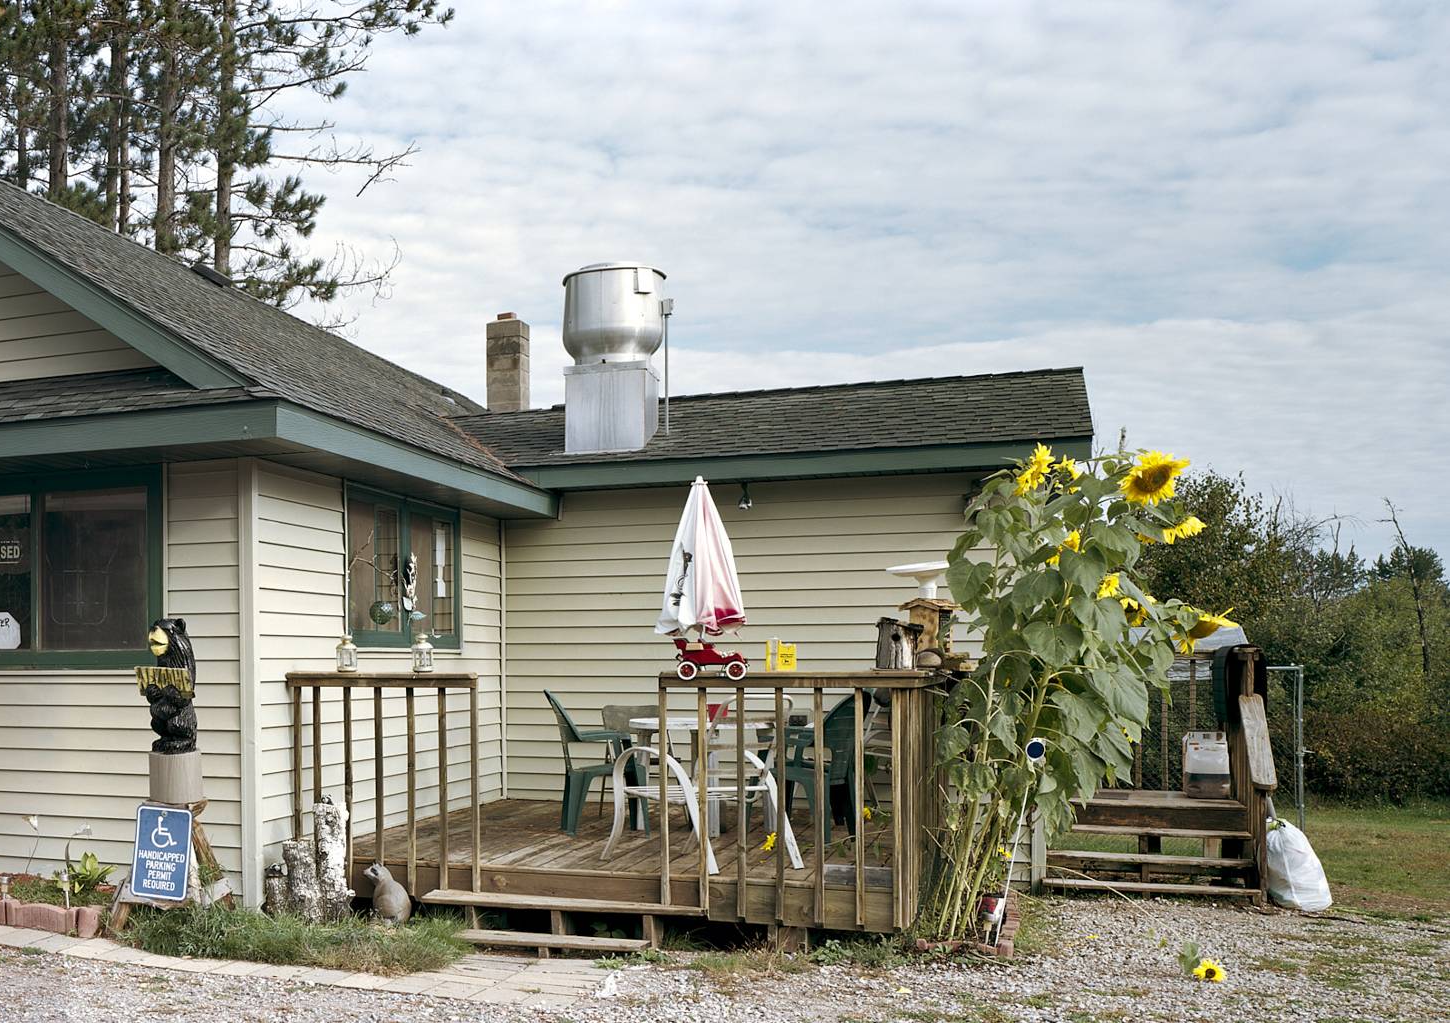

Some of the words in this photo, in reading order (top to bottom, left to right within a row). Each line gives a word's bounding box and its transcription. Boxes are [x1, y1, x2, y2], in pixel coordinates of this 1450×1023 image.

[138, 849, 185, 863] HANDICAPPED
[145, 860, 176, 872] PARKING
[147, 870, 172, 880] PERMIT
[142, 879, 176, 891] REQUIRED
